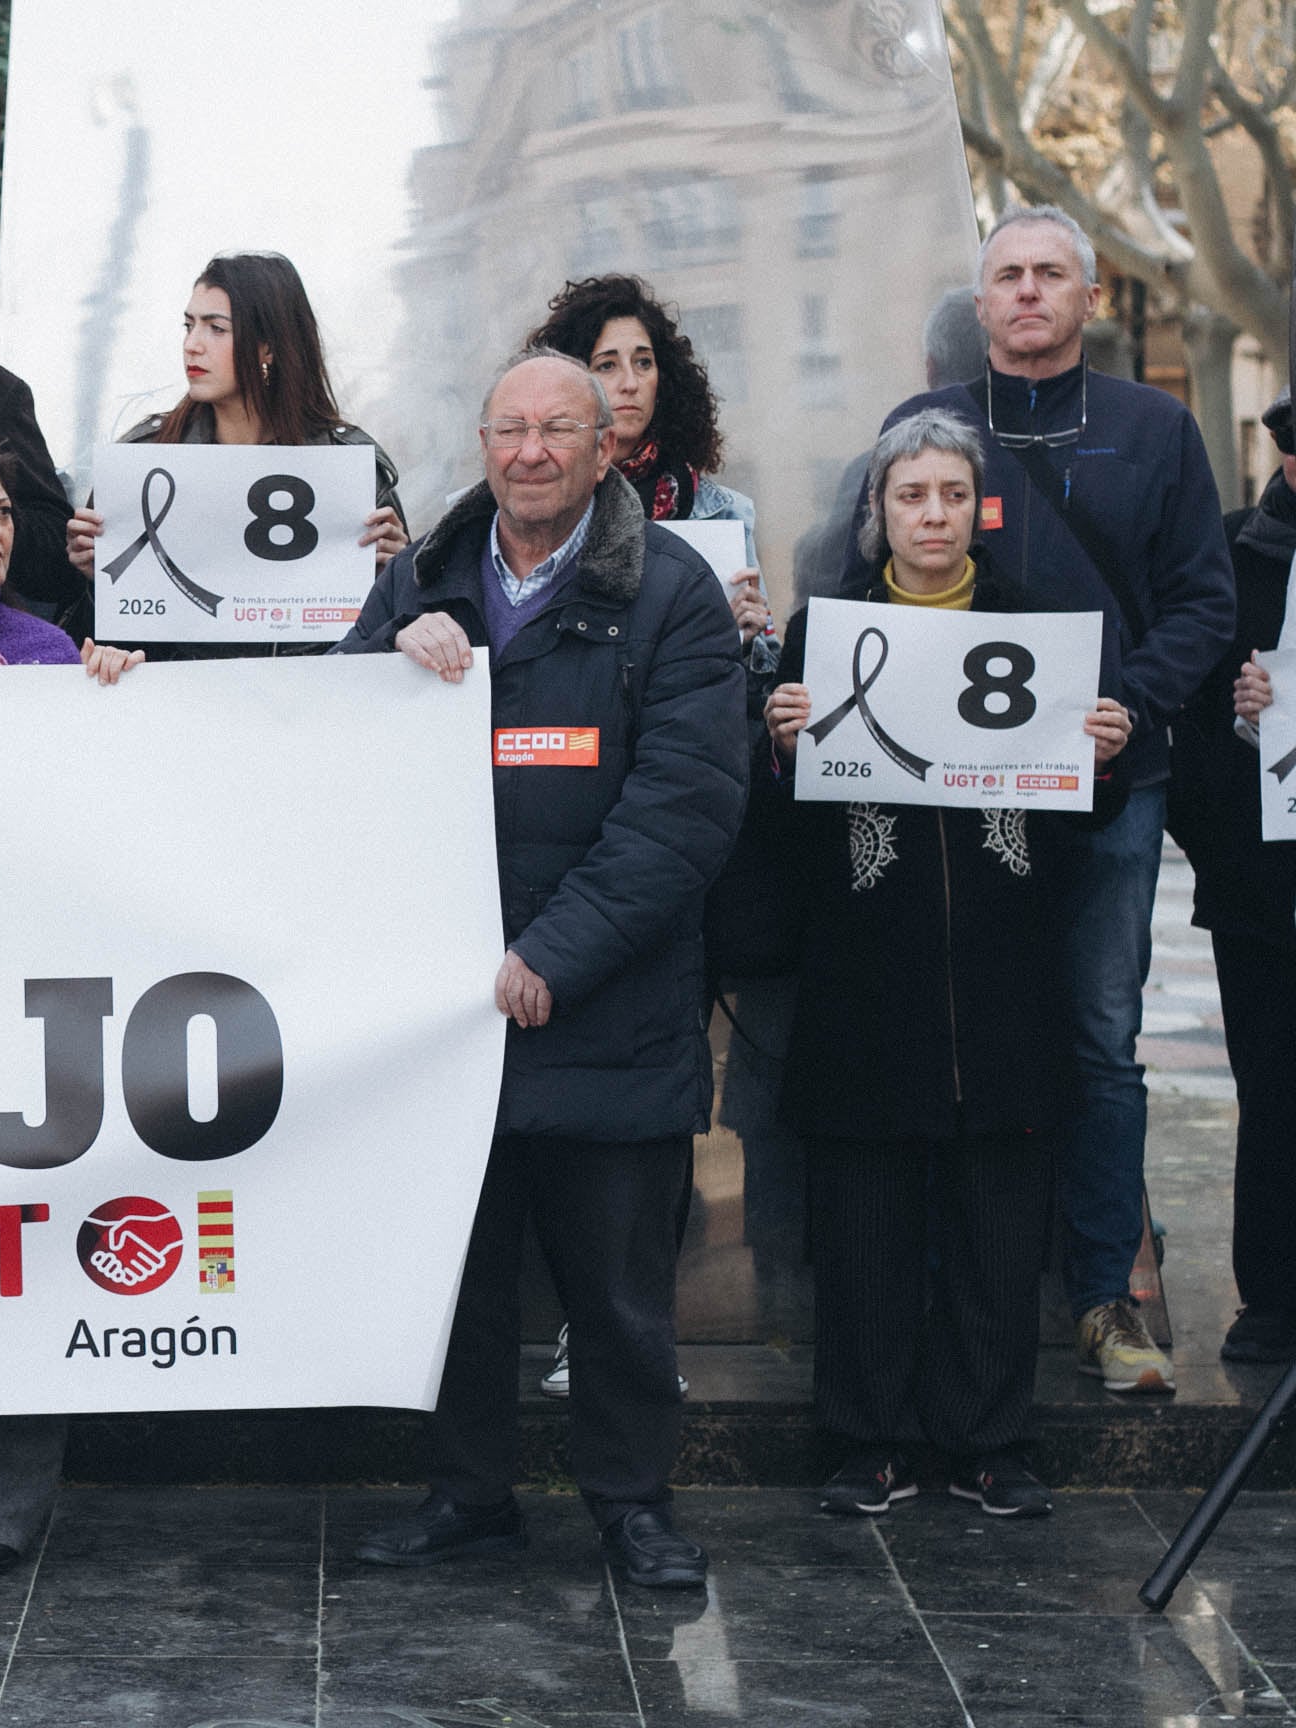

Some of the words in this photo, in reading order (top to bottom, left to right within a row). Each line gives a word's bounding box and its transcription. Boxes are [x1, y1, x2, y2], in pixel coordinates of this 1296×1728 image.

[243, 474, 319, 561] 8
[118, 598, 166, 616] 2026
[234, 608, 266, 621] UGT
[957, 641, 1037, 730] 8
[498, 733, 566, 750] CCOO
[498, 752, 534, 763] Aragón
[821, 760, 872, 779] 2026
[944, 774, 979, 787] UGT
[65, 1316, 238, 1369] Aragón
